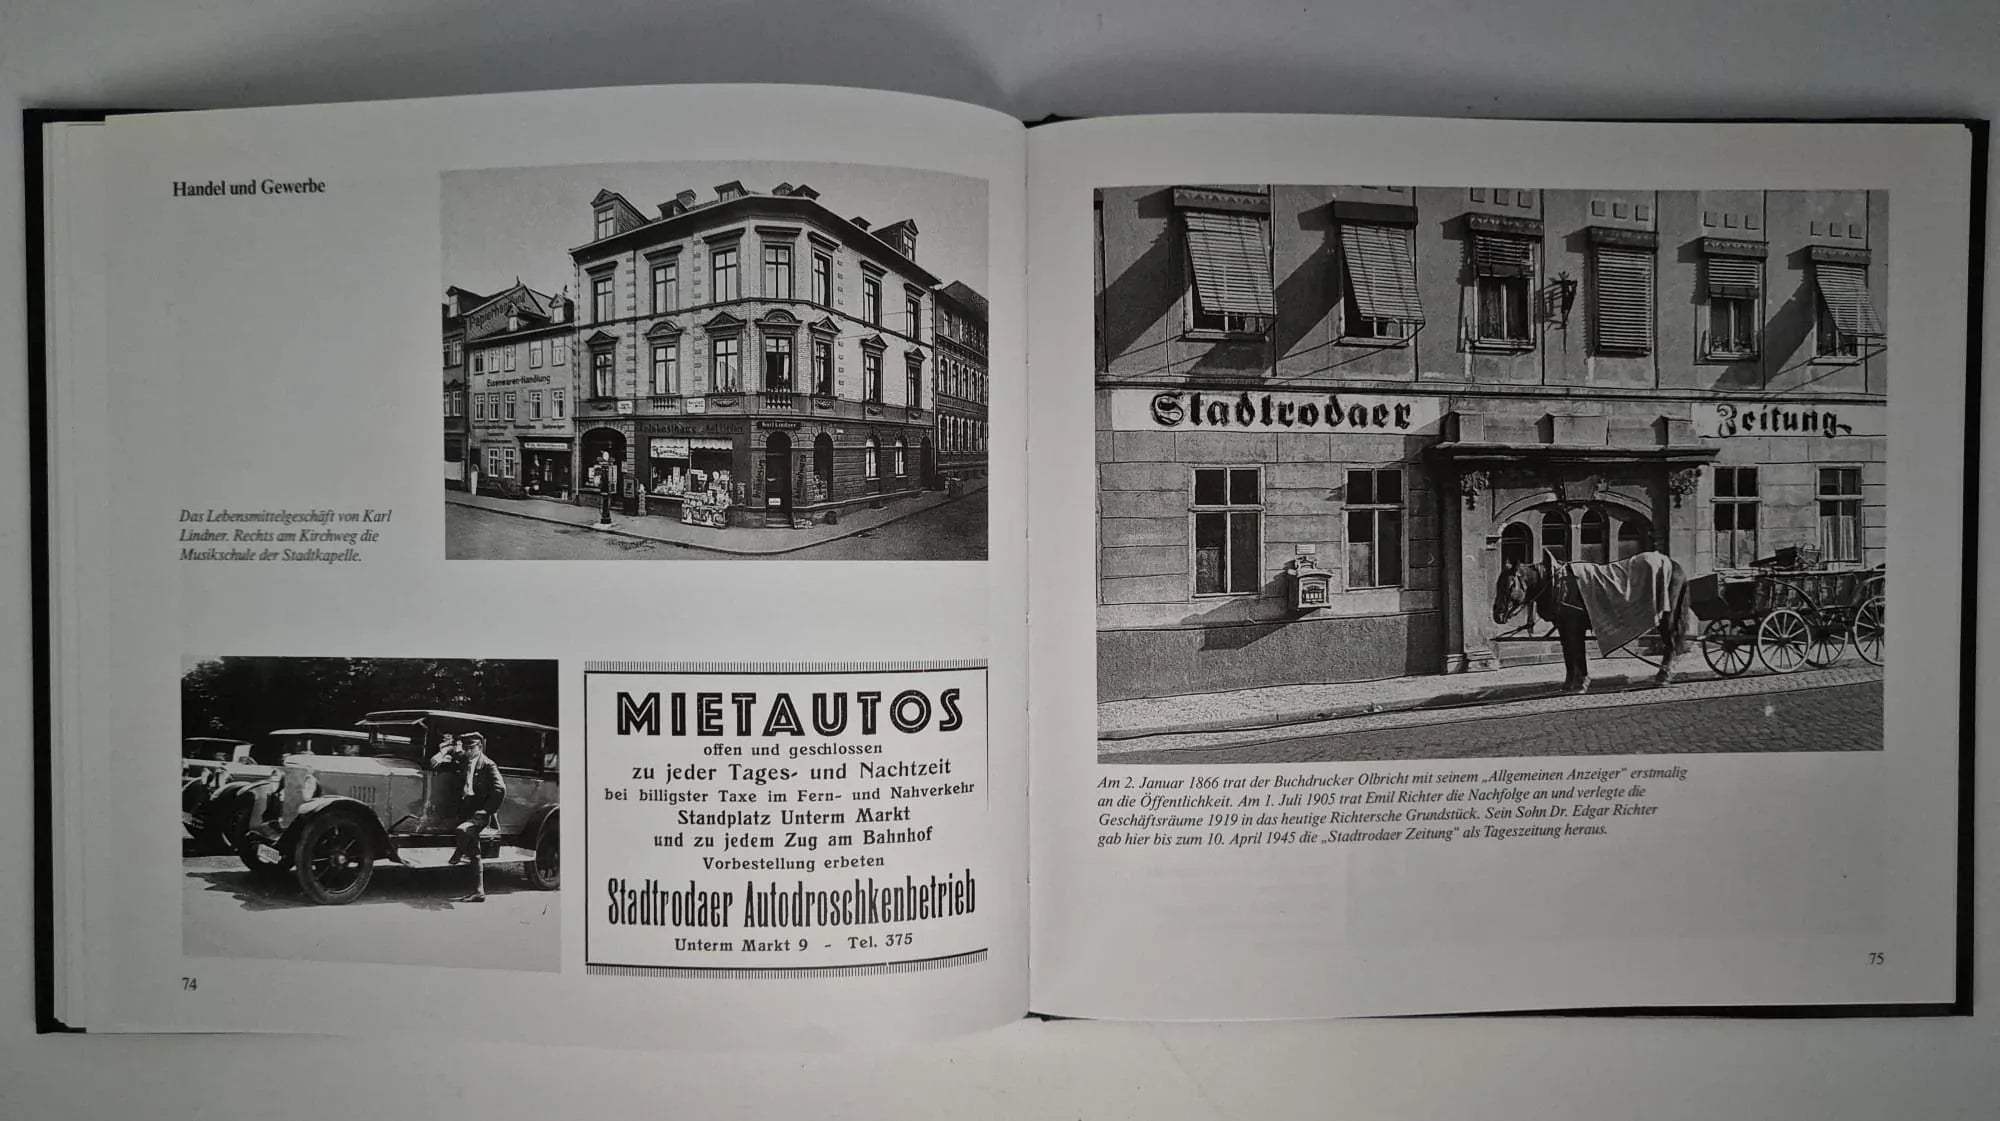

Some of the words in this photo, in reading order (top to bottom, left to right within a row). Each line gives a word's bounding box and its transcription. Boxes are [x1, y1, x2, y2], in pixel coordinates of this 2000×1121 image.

[173, 181, 225, 196] Handel
[230, 179, 256, 195] und
[261, 178, 325, 194] Gewerbe
[1151, 391, 1411, 429] Stadtrodaer
[1716, 403, 1853, 439] Zeitung
[179, 509, 204, 522] Das
[206, 509, 335, 526] Lebensmittelgeschäft
[338, 513, 359, 522] von
[362, 510, 392, 522] Karl
[179, 529, 228, 541] Lindner.
[233, 529, 273, 541] Rechts
[276, 533, 296, 542] am
[299, 529, 358, 545] Kirchweg
[360, 529, 379, 542] die
[180, 548, 256, 560] Musikschule
[259, 548, 280, 561] der
[282, 548, 361, 565] Stadtkapelle.
[617, 688, 962, 736] MIETAUTOS
[704, 743, 742, 755] offen
[752, 744, 779, 755] und
[789, 743, 882, 759] geschlossen
[633, 768, 654, 779] zu
[666, 763, 717, 784] jeder
[728, 764, 797, 785] Tages-
[811, 763, 846, 779] und
[860, 758, 951, 778] Nachtzeit
[1097, 777, 1120, 788] Am
[1124, 776, 1134, 788] 2.
[1139, 777, 1184, 788] Januar
[1190, 777, 1219, 789] 1866
[1223, 779, 1246, 788] trat
[1250, 776, 1270, 788] der
[1274, 774, 1354, 787] Buchdrucker
[1358, 772, 1408, 785] Olbricht
[1412, 772, 1433, 784] mit
[1436, 771, 1478, 783] seinem
[1482, 769, 1563, 784] „Allgemeinen
[1630, 766, 1688, 781] erstmalig
[605, 788, 627, 800] bei
[640, 789, 708, 805] billigster
[718, 790, 756, 802] Taxe
[768, 790, 787, 802] im
[797, 790, 841, 802] Fern-
[852, 788, 880, 800] und
[891, 782, 974, 799] Nahverkehr
[1098, 798, 1113, 807] an
[1117, 795, 1136, 807] die
[1141, 792, 1232, 810] Öffentlichkeit.
[1238, 795, 1260, 807] Am
[1266, 794, 1274, 806] 1.
[1278, 794, 1302, 806] Juli
[1307, 793, 1335, 805] 1905
[1340, 794, 1362, 804] trat
[1366, 791, 1395, 804] Emil
[1398, 790, 1443, 803] Richter
[1446, 789, 1464, 801] die
[1468, 787, 1530, 803] Nachfolge
[1533, 791, 1548, 799] an
[1552, 786, 1575, 798] und
[1578, 786, 1625, 800] verlegte
[1628, 785, 1646, 797] die
[678, 810, 771, 828] Standplatz
[781, 810, 844, 824] Unterm
[856, 806, 910, 822] Markt
[1099, 814, 1203, 829] Geschäftsräume
[1208, 814, 1238, 826] 1919
[1242, 814, 1253, 825] in
[1256, 813, 1278, 825] das
[1281, 812, 1327, 827] heutige
[1330, 810, 1402, 823] Richtersche
[1406, 807, 1480, 821] Grundstück.
[1485, 807, 1511, 819] Sein
[1516, 806, 1546, 818] Sohn
[1549, 805, 1567, 817] Dr.
[1572, 805, 1610, 819] Edgar
[1613, 804, 1658, 815] Richter
[654, 832, 683, 847] und
[694, 837, 714, 847] zu
[724, 833, 773, 851] jedem
[784, 833, 817, 851] Zug
[828, 835, 852, 846] am
[863, 826, 933, 844] Bahnhof
[1098, 832, 1121, 847] gab
[1125, 833, 1150, 845] hier
[1154, 833, 1172, 845] bis
[1176, 837, 1202, 845] zum
[1208, 833, 1224, 845] 10.
[1229, 832, 1262, 848] April
[1267, 832, 1296, 844] 1945
[1299, 831, 1317, 843] die
[1322, 828, 1402, 844] „Stadtrodaer
[1463, 826, 1480, 838] als
[1484, 825, 1561, 840] Tageszeitung
[1564, 823, 1607, 835] heraus.
[703, 857, 815, 872] Vorbestellung
[824, 856, 884, 868] erbeten
[608, 878, 733, 927] Stadtrodaer
[742, 865, 975, 927] Autodroschkenbetrieb
[675, 938, 732, 951] Unterm
[741, 939, 790, 951] Markt
[799, 939, 808, 951] 9
[848, 936, 877, 949] Tel.
[885, 933, 912, 946] 375
[1869, 952, 1884, 965] 75
[182, 977, 197, 990] 74
